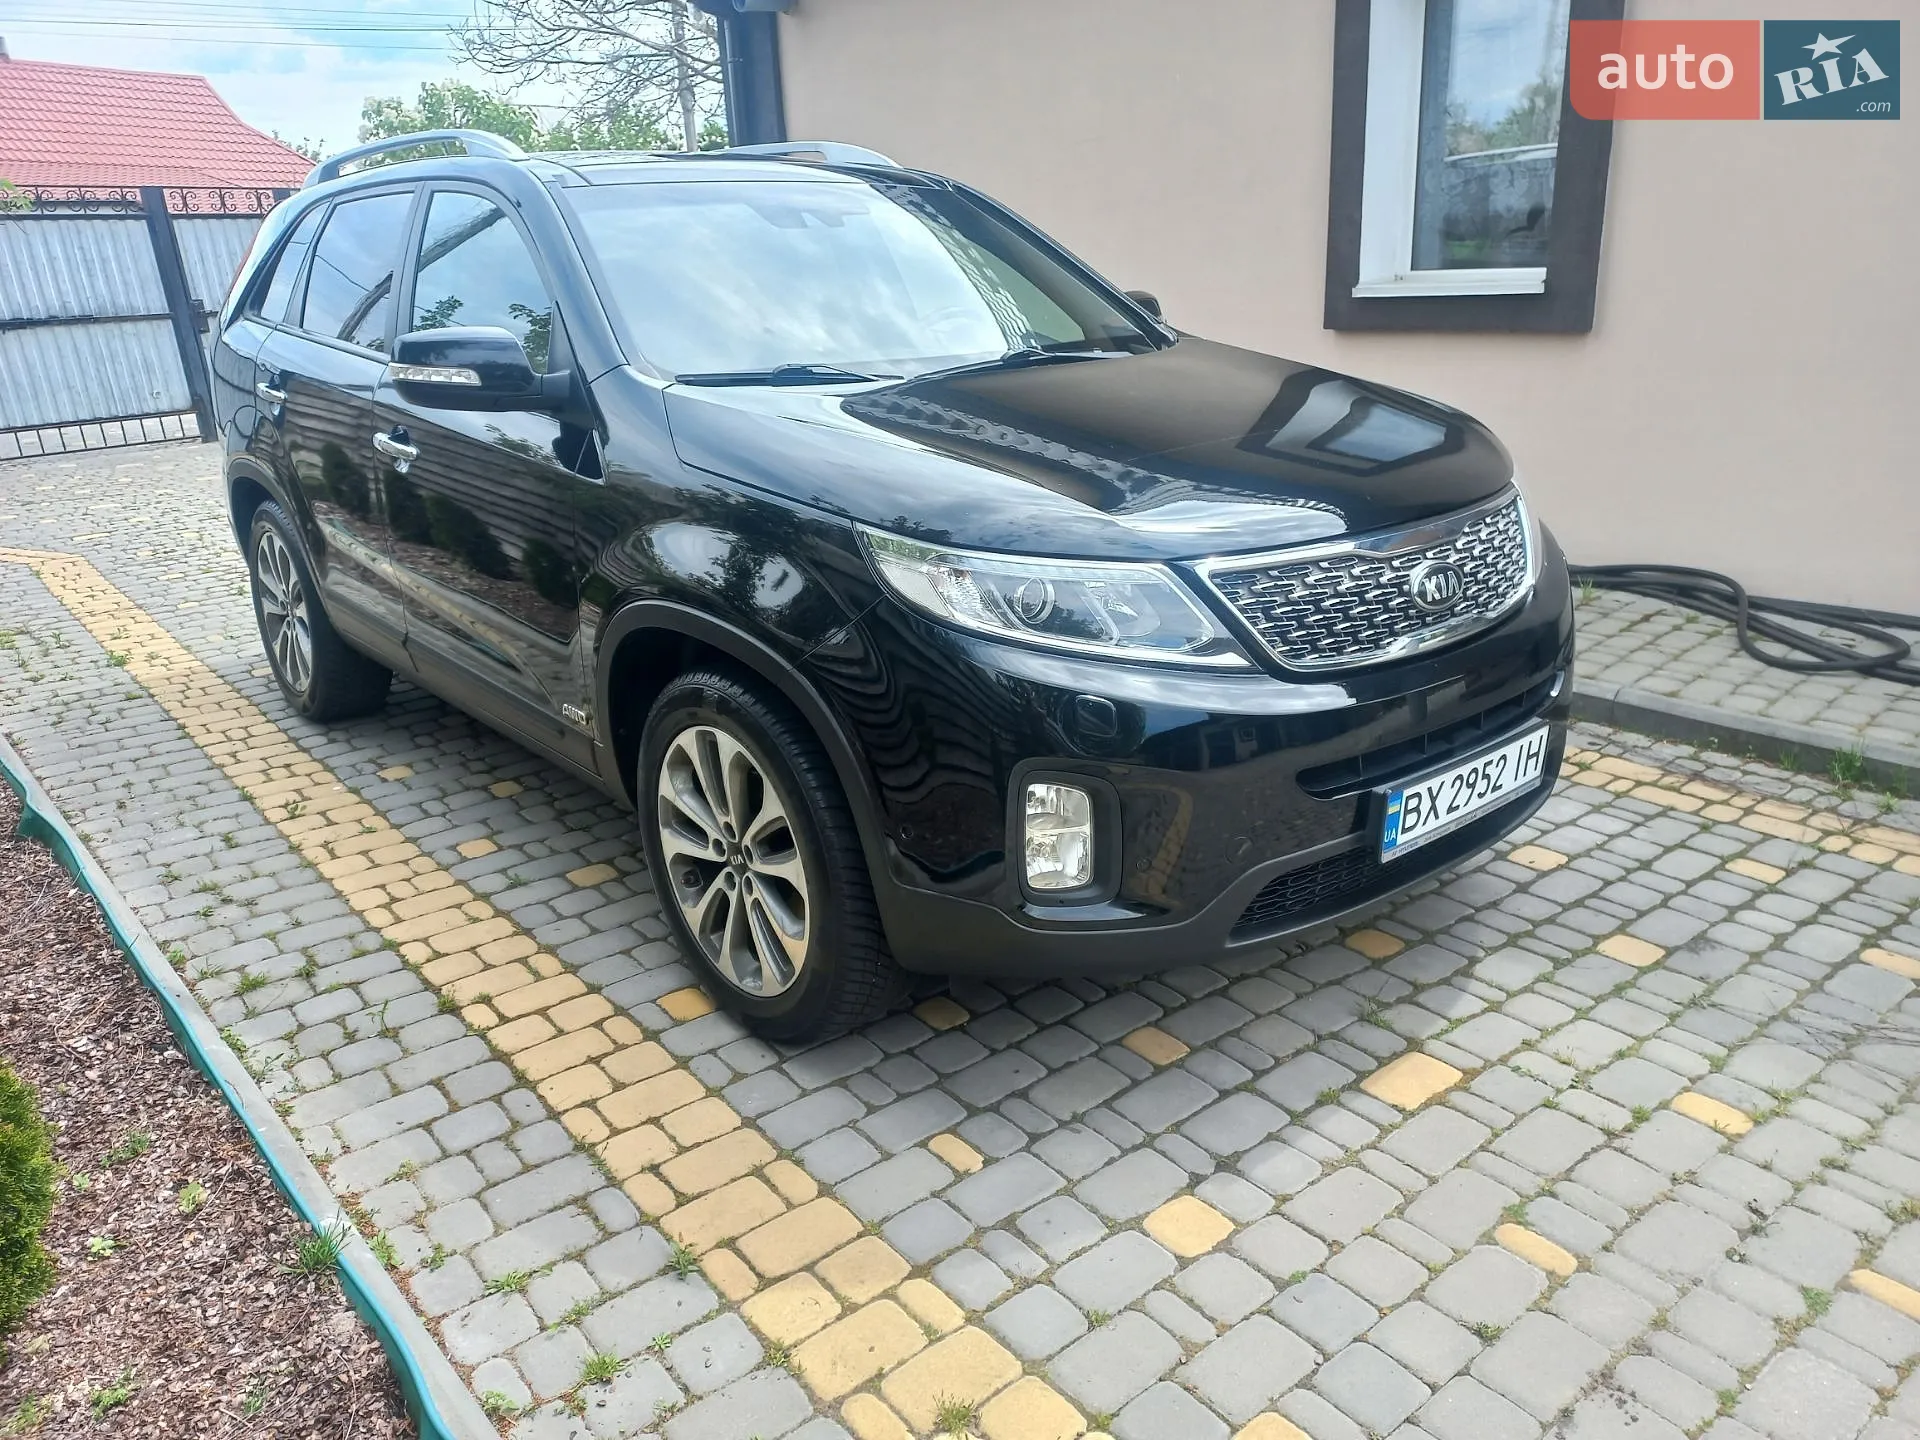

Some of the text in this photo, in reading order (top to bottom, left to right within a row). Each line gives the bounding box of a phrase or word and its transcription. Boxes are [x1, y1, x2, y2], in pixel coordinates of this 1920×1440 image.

[1422, 570, 1460, 602] KIA
[1400, 734, 1544, 835] BX 2952 IH
[1384, 827, 1397, 843] UA
